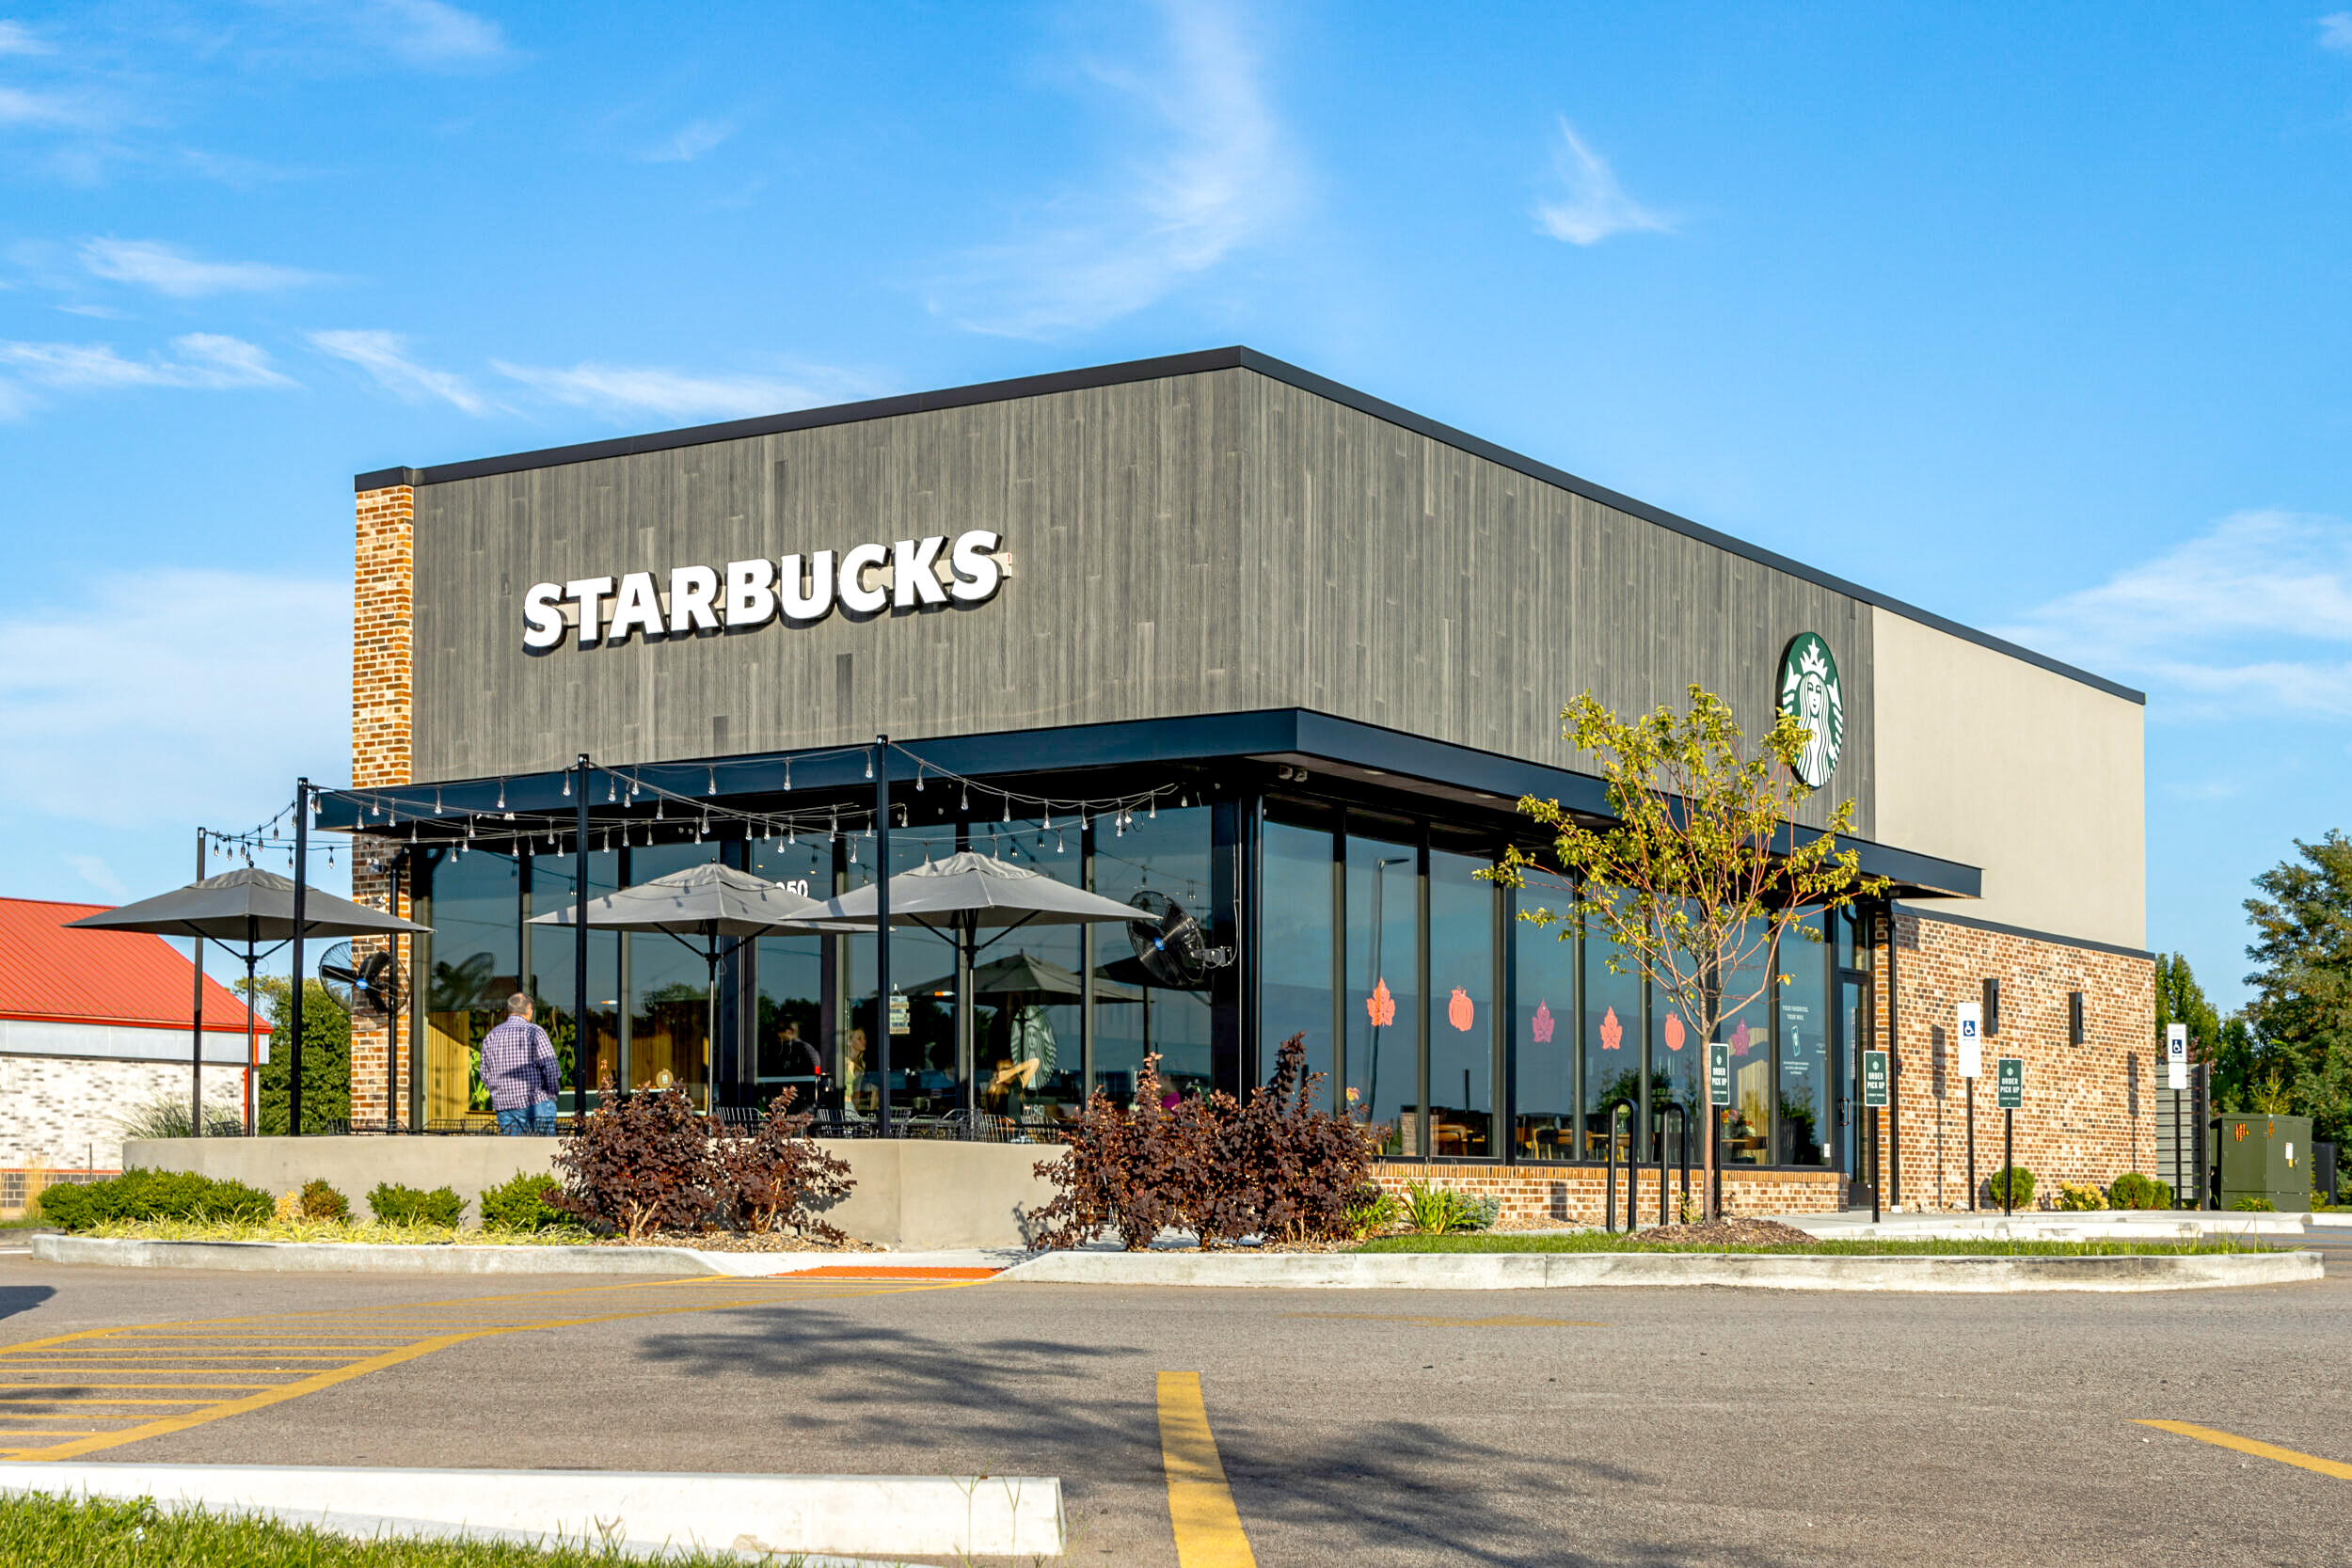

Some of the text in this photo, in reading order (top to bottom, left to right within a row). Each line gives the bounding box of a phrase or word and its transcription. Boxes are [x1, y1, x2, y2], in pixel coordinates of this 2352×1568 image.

[524, 531, 1001, 653] STARBUCKS
[1712, 1067, 1726, 1076] ORDER
[1867, 1071, 1884, 1080] ORDER
[1711, 1077, 1727, 1086] PICK UP
[1867, 1081, 1885, 1089] PICK UP
[2001, 1077, 2019, 1085] ORDER
[1999, 1085, 2020, 1094] PICK UP
